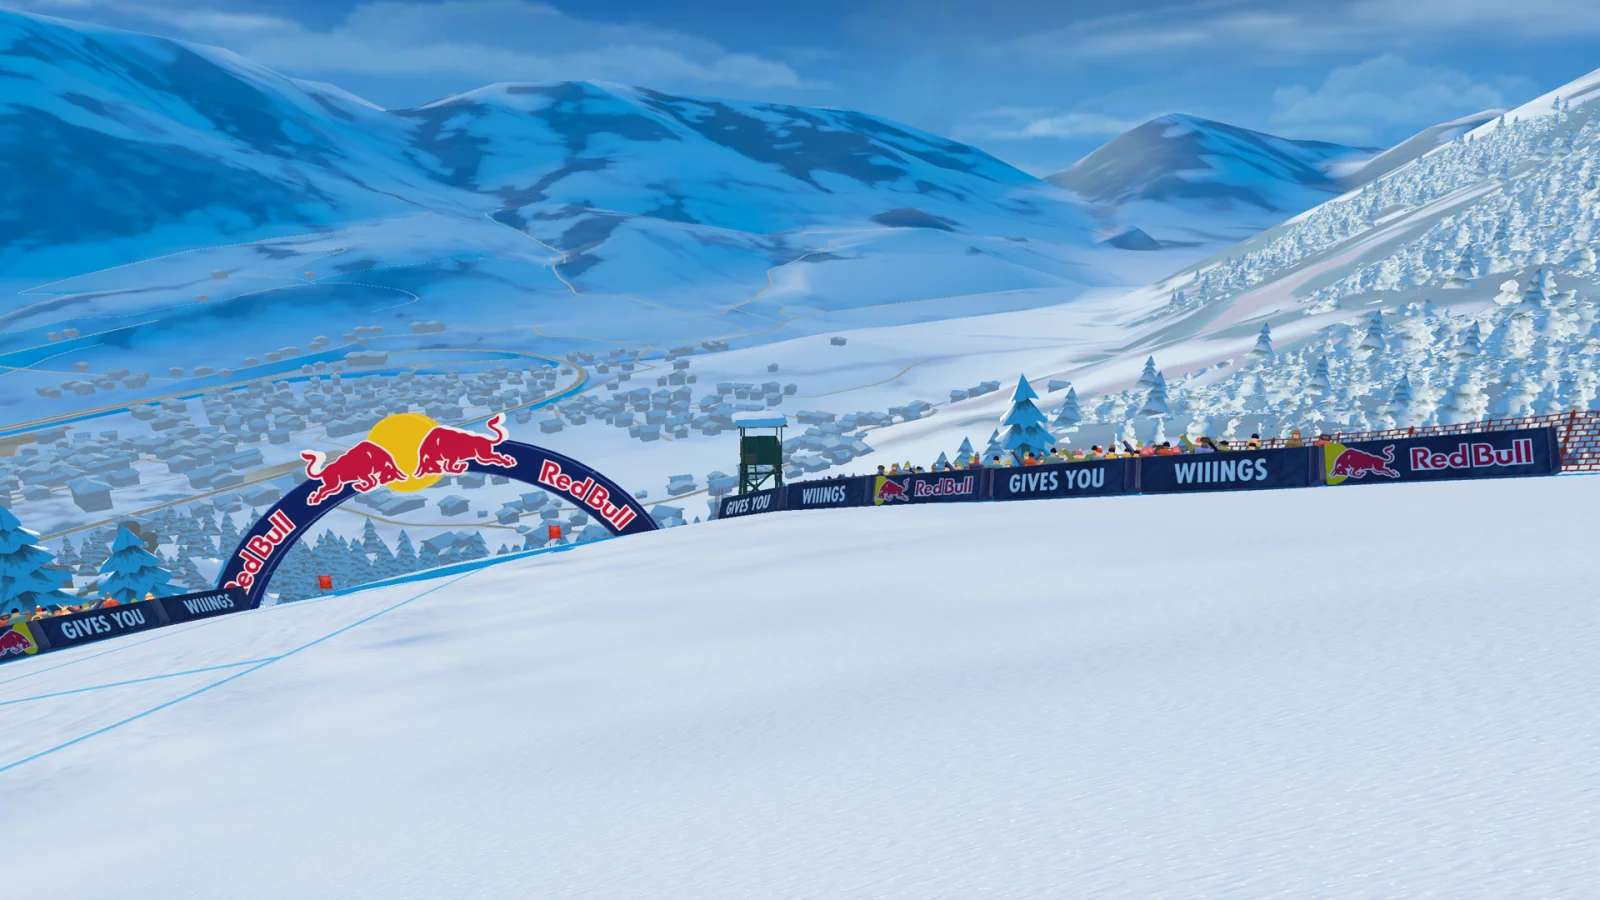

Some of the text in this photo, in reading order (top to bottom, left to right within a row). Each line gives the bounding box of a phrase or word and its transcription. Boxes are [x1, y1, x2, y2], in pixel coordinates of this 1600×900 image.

[1410, 438, 1534, 471] Red Bull
[1009, 467, 1105, 493] GIVES YOU
[1174, 458, 1268, 484] WIIINGS
[538, 459, 637, 531] Red Bull
[803, 485, 846, 504] WIIINGS
[914, 476, 973, 497] Red Bull
[726, 494, 771, 515] GIVES YOU
[245, 509, 297, 560] Bull
[183, 593, 235, 615] WIIINGS
[61, 608, 146, 639] GIVES YOU
